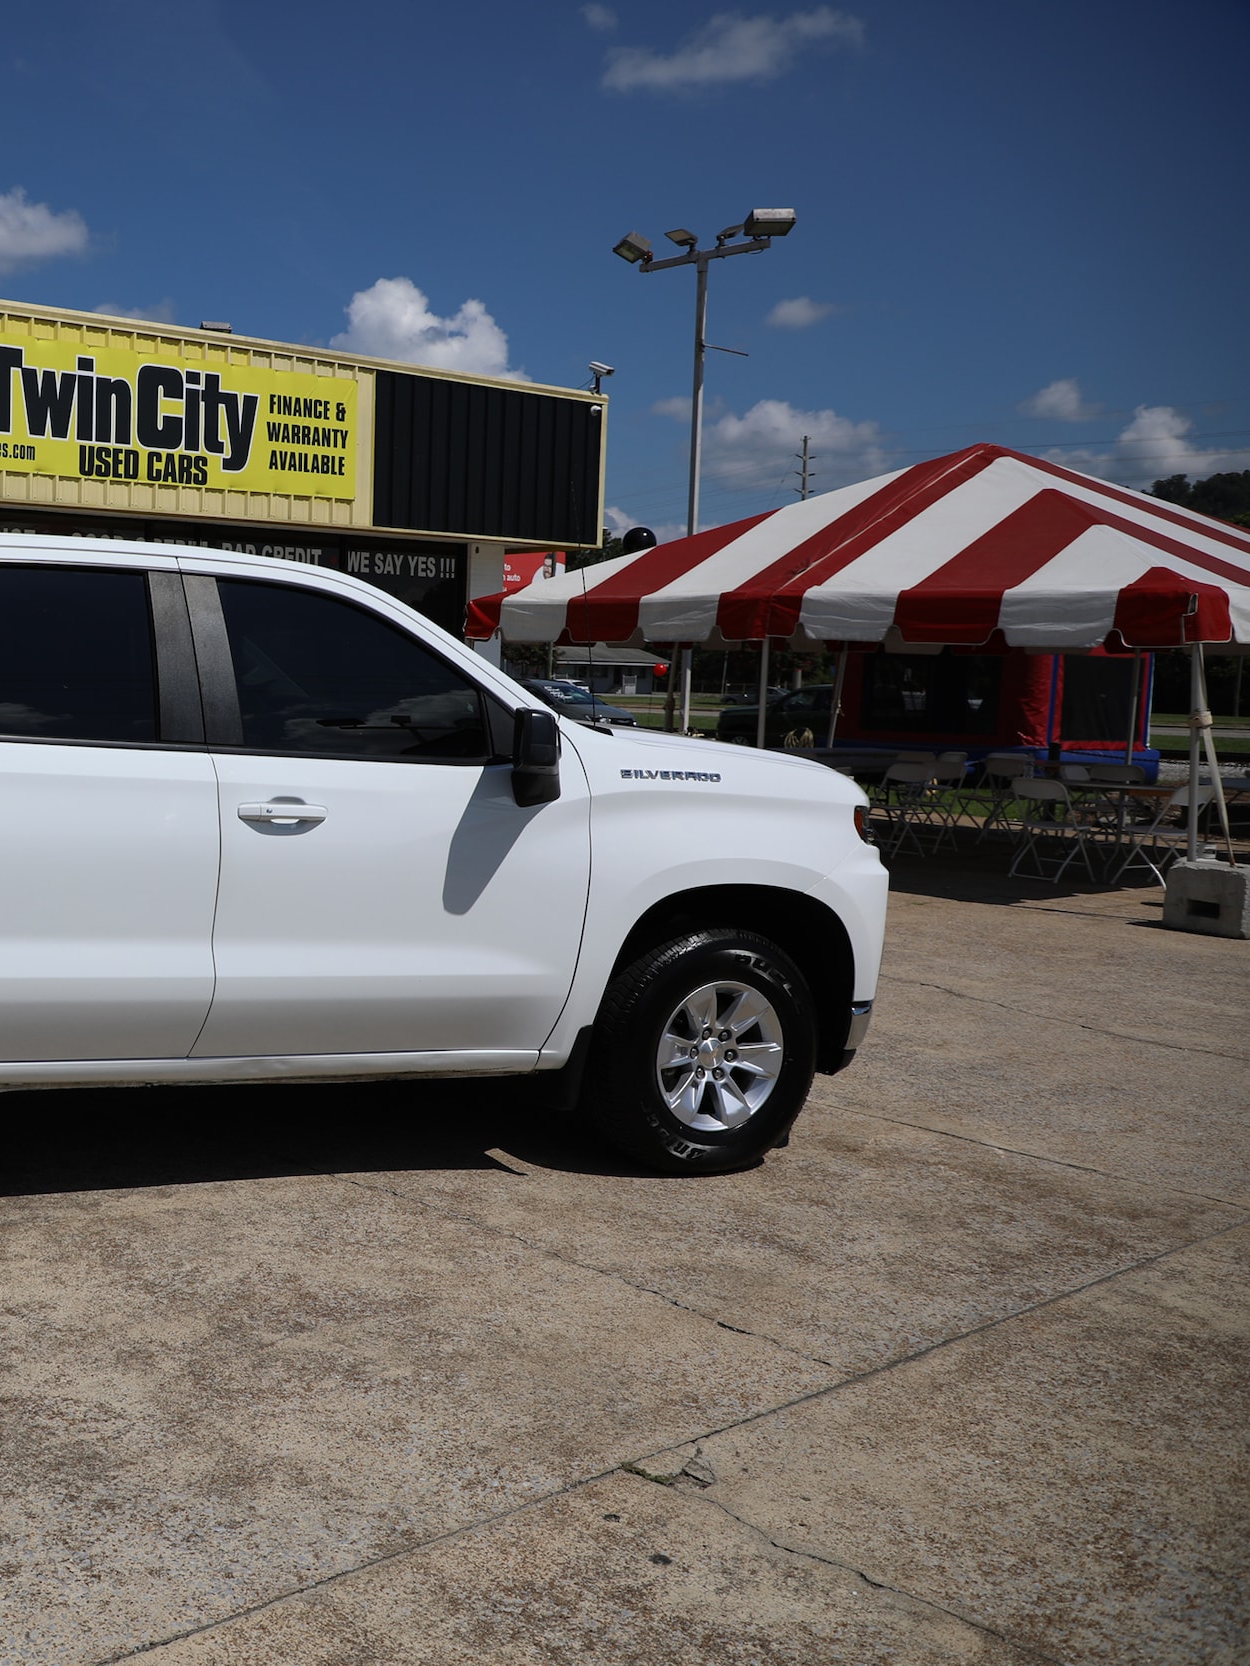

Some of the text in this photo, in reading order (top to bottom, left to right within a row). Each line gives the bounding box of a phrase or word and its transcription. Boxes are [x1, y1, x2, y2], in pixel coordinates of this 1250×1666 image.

[269, 394, 347, 422] FINANCE &
[266, 421, 349, 449] WARRANTY
[79, 445, 209, 486] USED CARS
[268, 449, 345, 476] AVAILABLE
[347, 550, 371, 573] WE
[373, 552, 405, 576] SAY
[407, 555, 437, 578] YES
[620, 768, 722, 783] SILVERADO
